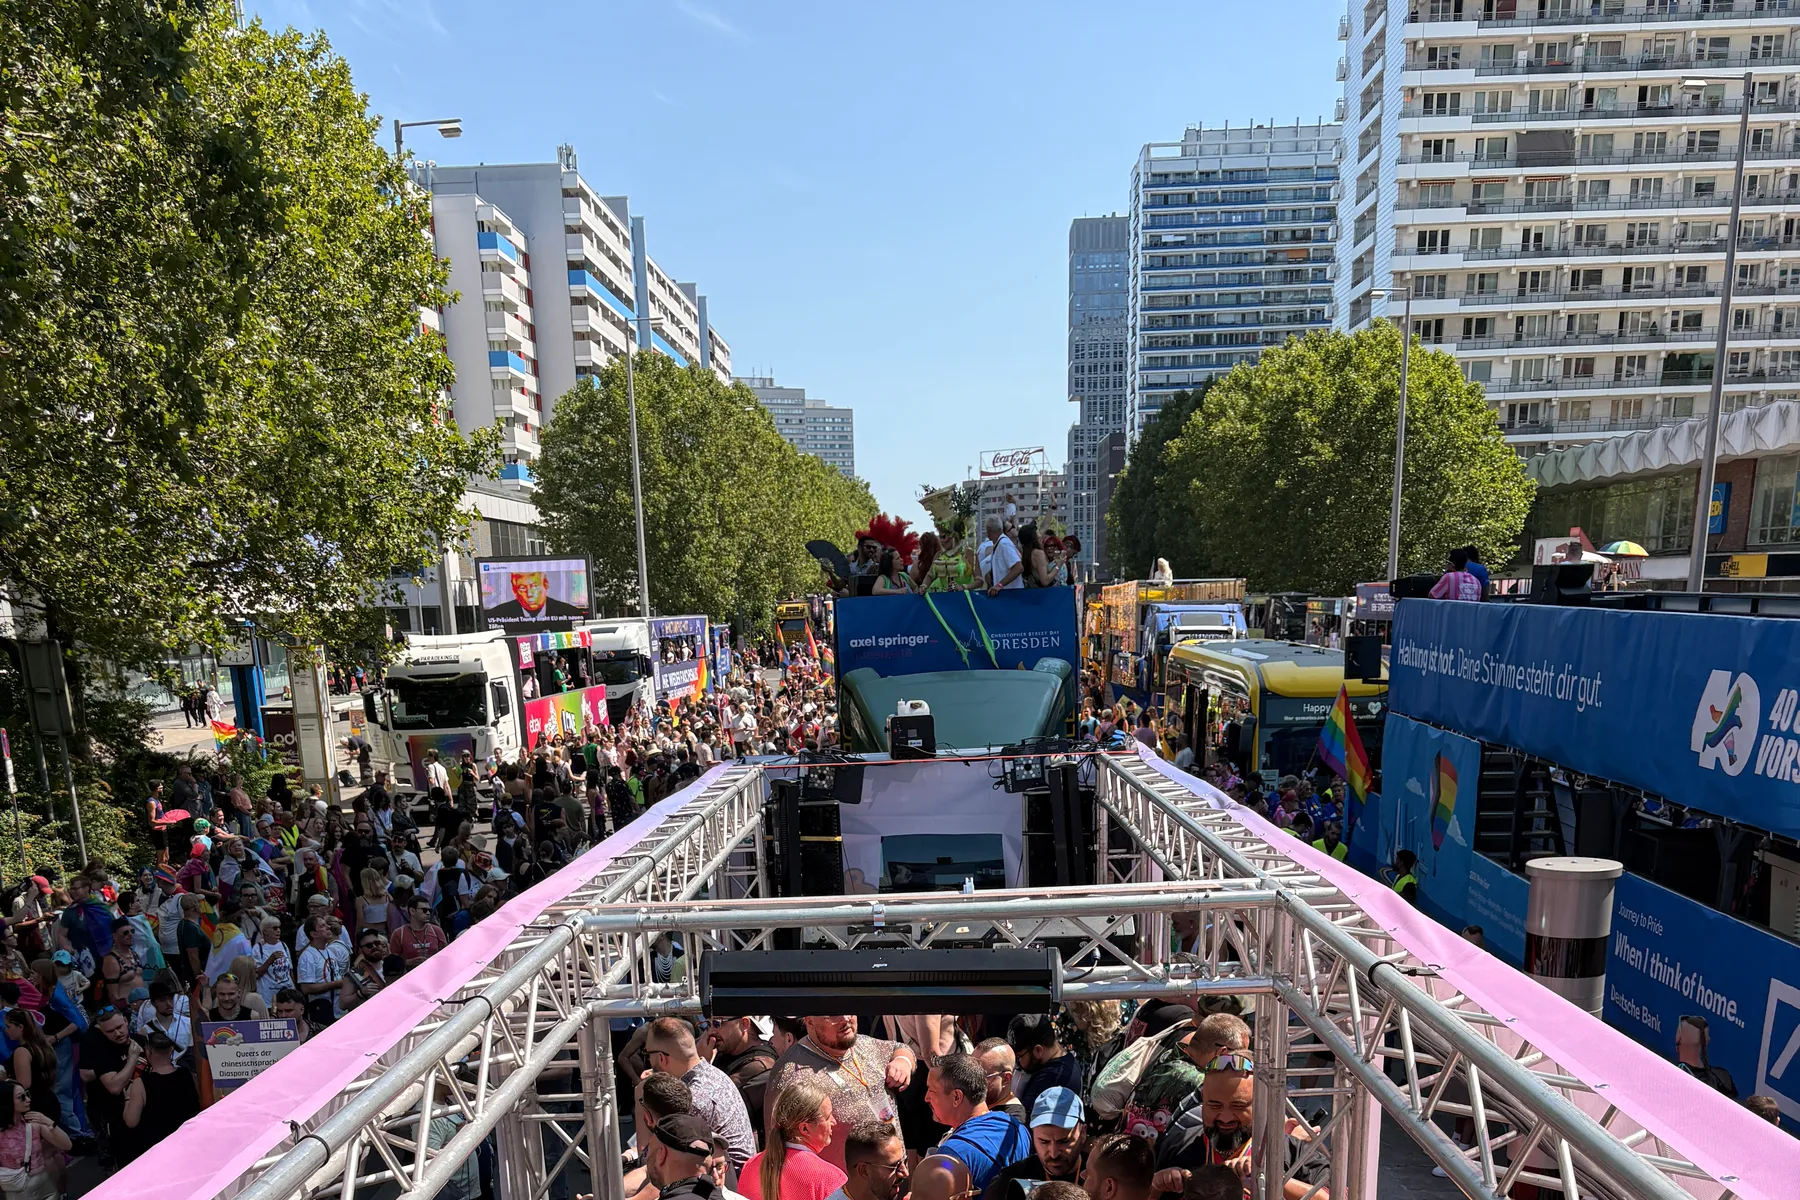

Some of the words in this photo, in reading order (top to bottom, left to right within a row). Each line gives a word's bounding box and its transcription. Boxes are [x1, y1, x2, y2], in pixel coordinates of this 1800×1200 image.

[850, 635, 876, 648] axel
[878, 633, 930, 648] springer
[990, 636, 1060, 650] DRESDEN
[1398, 638, 1428, 676] Haltung
[1427, 642, 1438, 671] ist
[1437, 643, 1455, 676] hot.
[1457, 648, 1480, 682] Deine
[1481, 652, 1525, 690] Stimme
[1524, 660, 1555, 697] steht
[1556, 662, 1578, 701] dir
[1576, 671, 1603, 712] gut.
[1303, 703, 1332, 714] Happy
[1768, 688, 1799, 732] 40
[1618, 901, 1640, 927] Journey
[1640, 912, 1647, 925] to
[1647, 915, 1663, 936] Pride
[1614, 930, 1642, 970] When
[1642, 947, 1649, 974] I
[1649, 952, 1682, 991] think
[1682, 972, 1697, 1000] of
[1610, 984, 1640, 1020] Deutsche
[1641, 1005, 1662, 1034] Bank
[260, 1030, 271, 1040] IST
[270, 1029, 284, 1039] HOT
[235, 1050, 260, 1058] Queers
[219, 1069, 250, 1077] Diaspora
